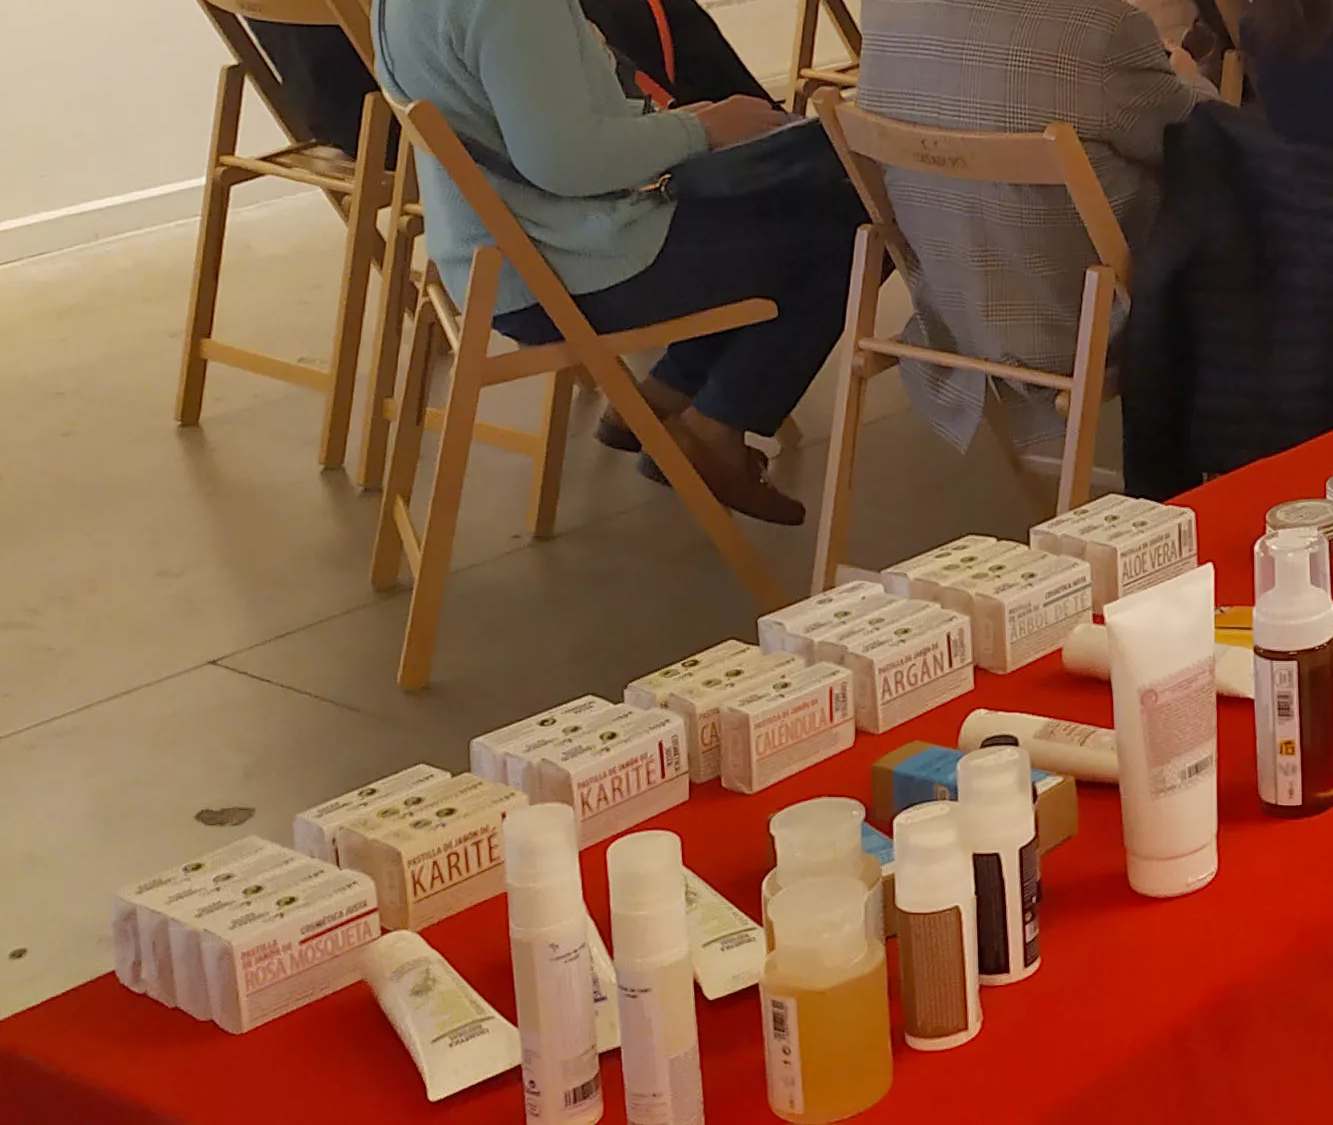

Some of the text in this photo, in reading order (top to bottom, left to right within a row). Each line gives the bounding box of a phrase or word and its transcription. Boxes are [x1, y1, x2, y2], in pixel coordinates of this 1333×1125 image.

[1122, 539, 1178, 581] ALOE VERA
[579, 755, 657, 817] KARITÉ
[411, 827, 501, 898] KARITÉ
[289, 920, 373, 972] MOSQUETA
